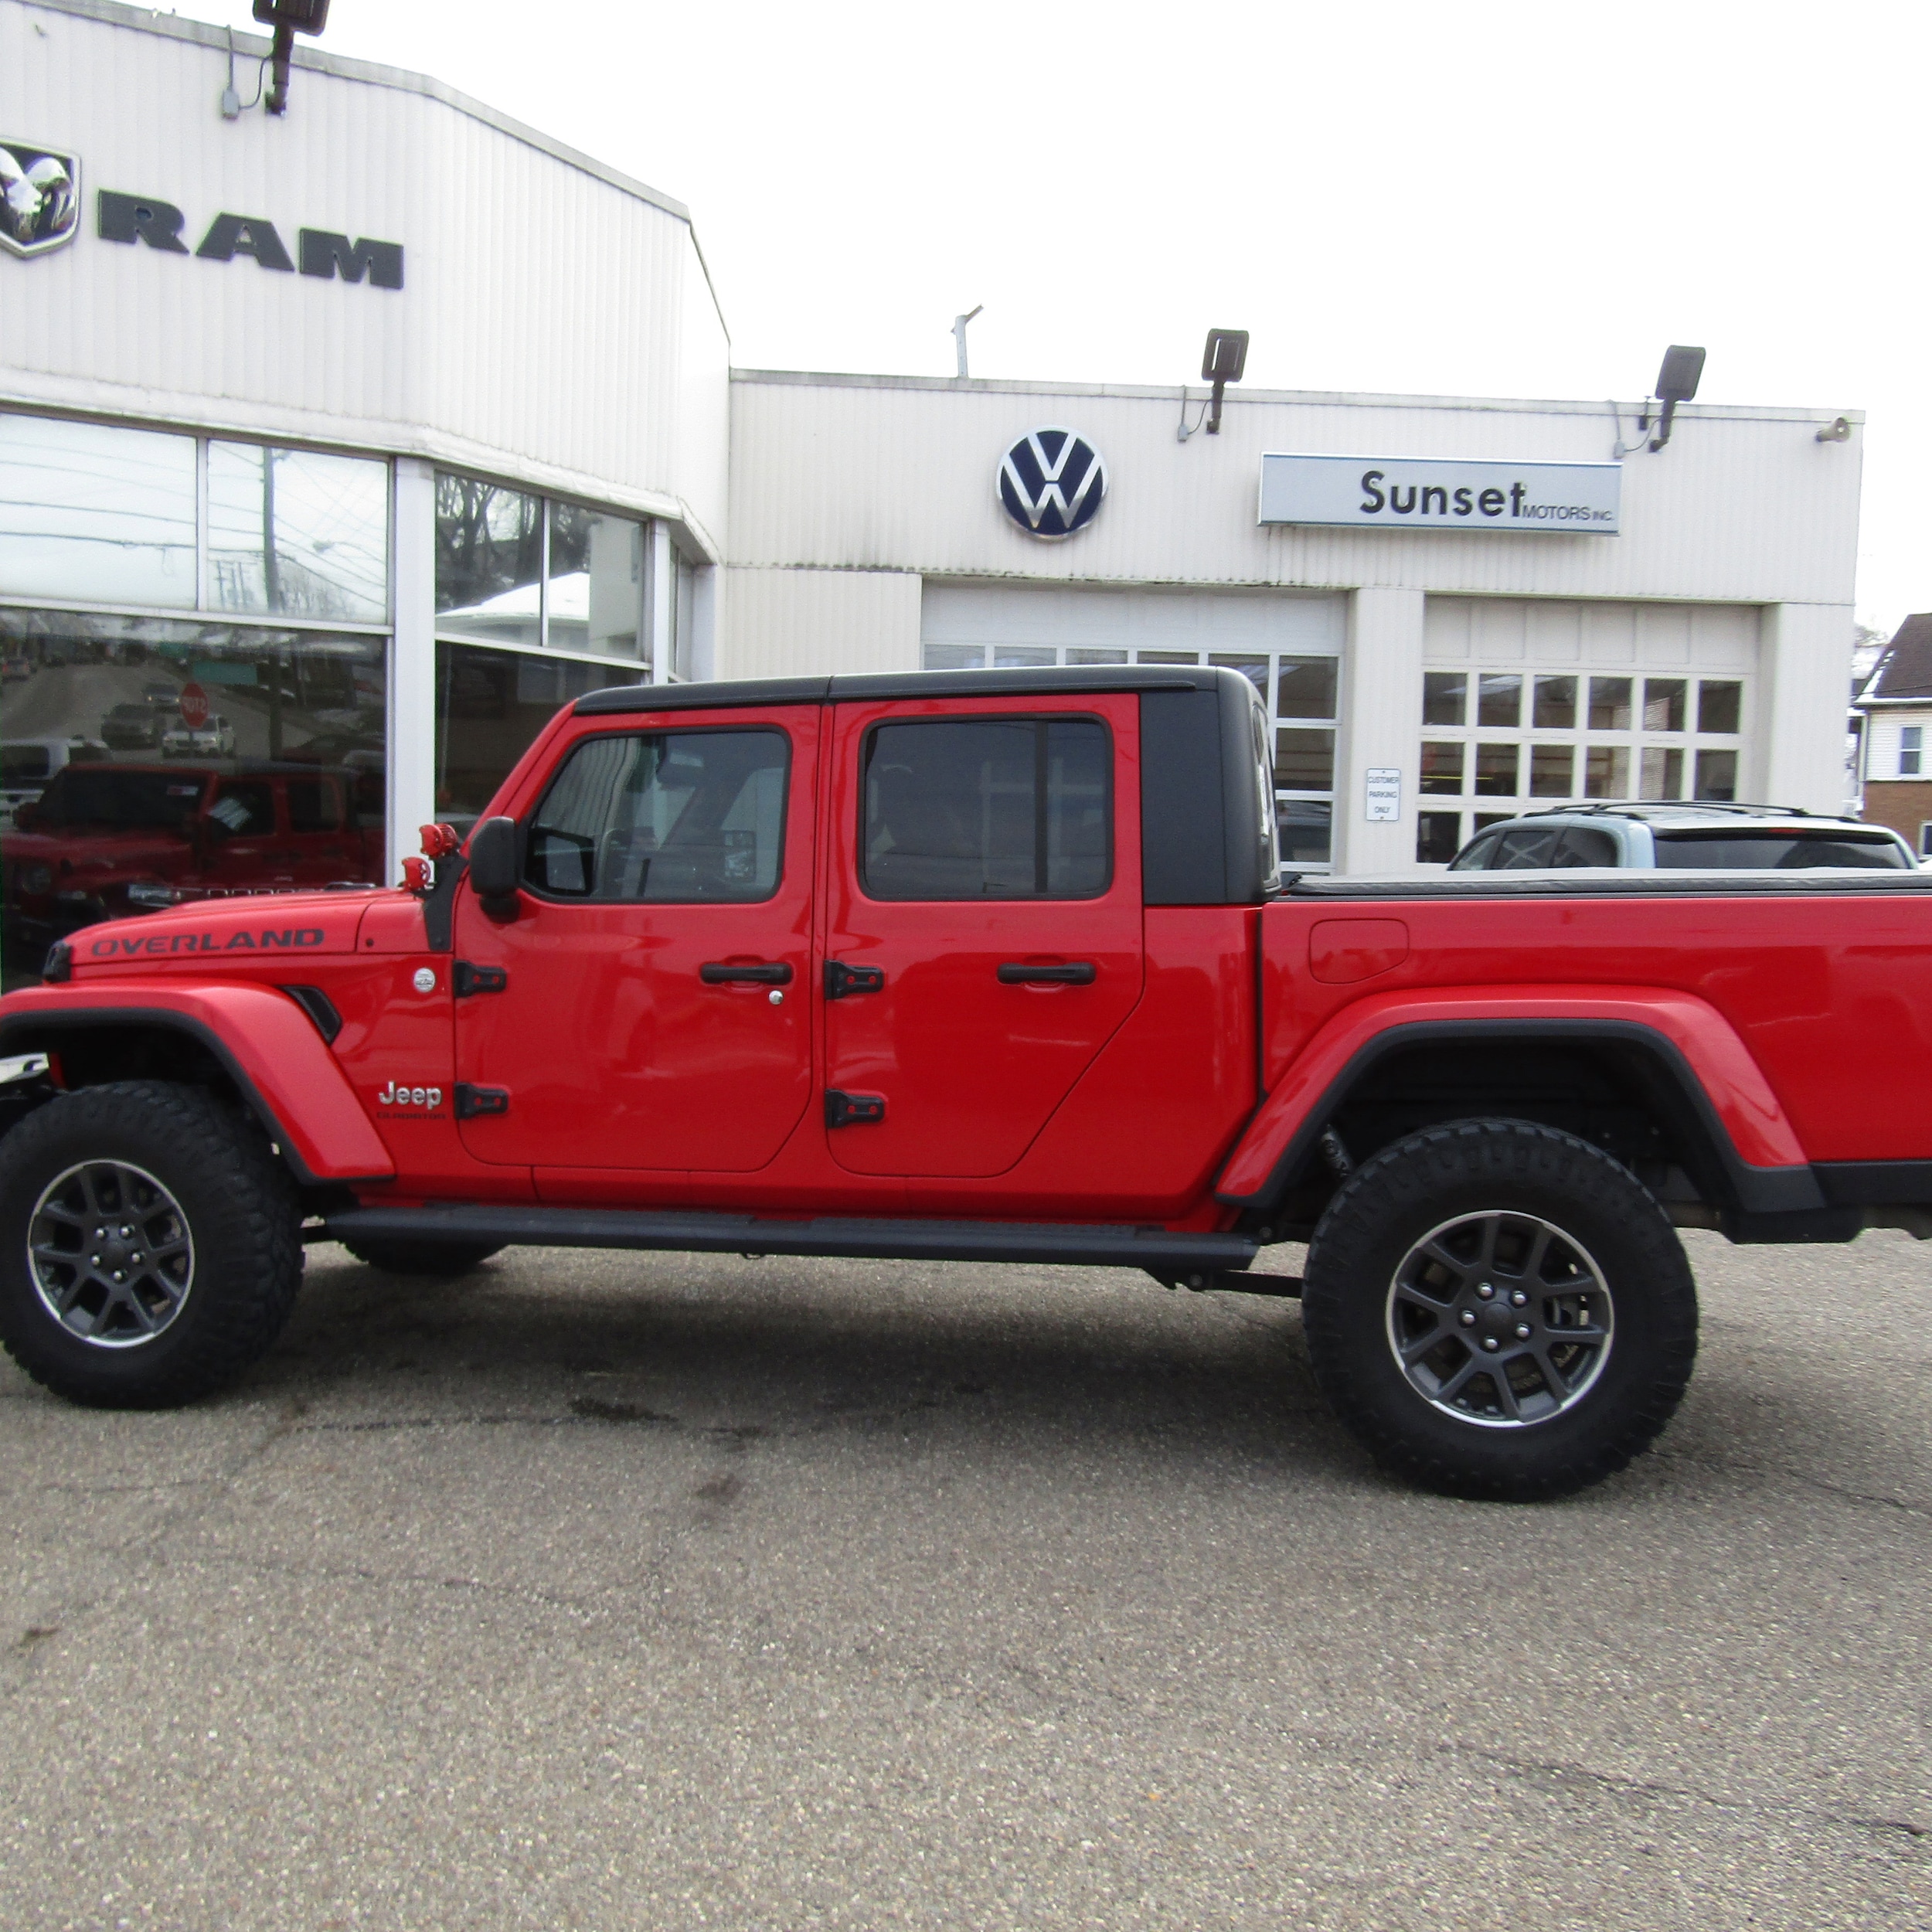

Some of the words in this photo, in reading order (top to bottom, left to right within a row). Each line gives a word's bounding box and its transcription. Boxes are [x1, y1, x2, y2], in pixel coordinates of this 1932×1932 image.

[98, 189, 403, 289] RAM
[1359, 470, 1526, 517] Sunset
[1522, 505, 1590, 520] MOTORS
[91, 928, 325, 957] OVERLAND
[379, 1080, 442, 1111] Jeep
